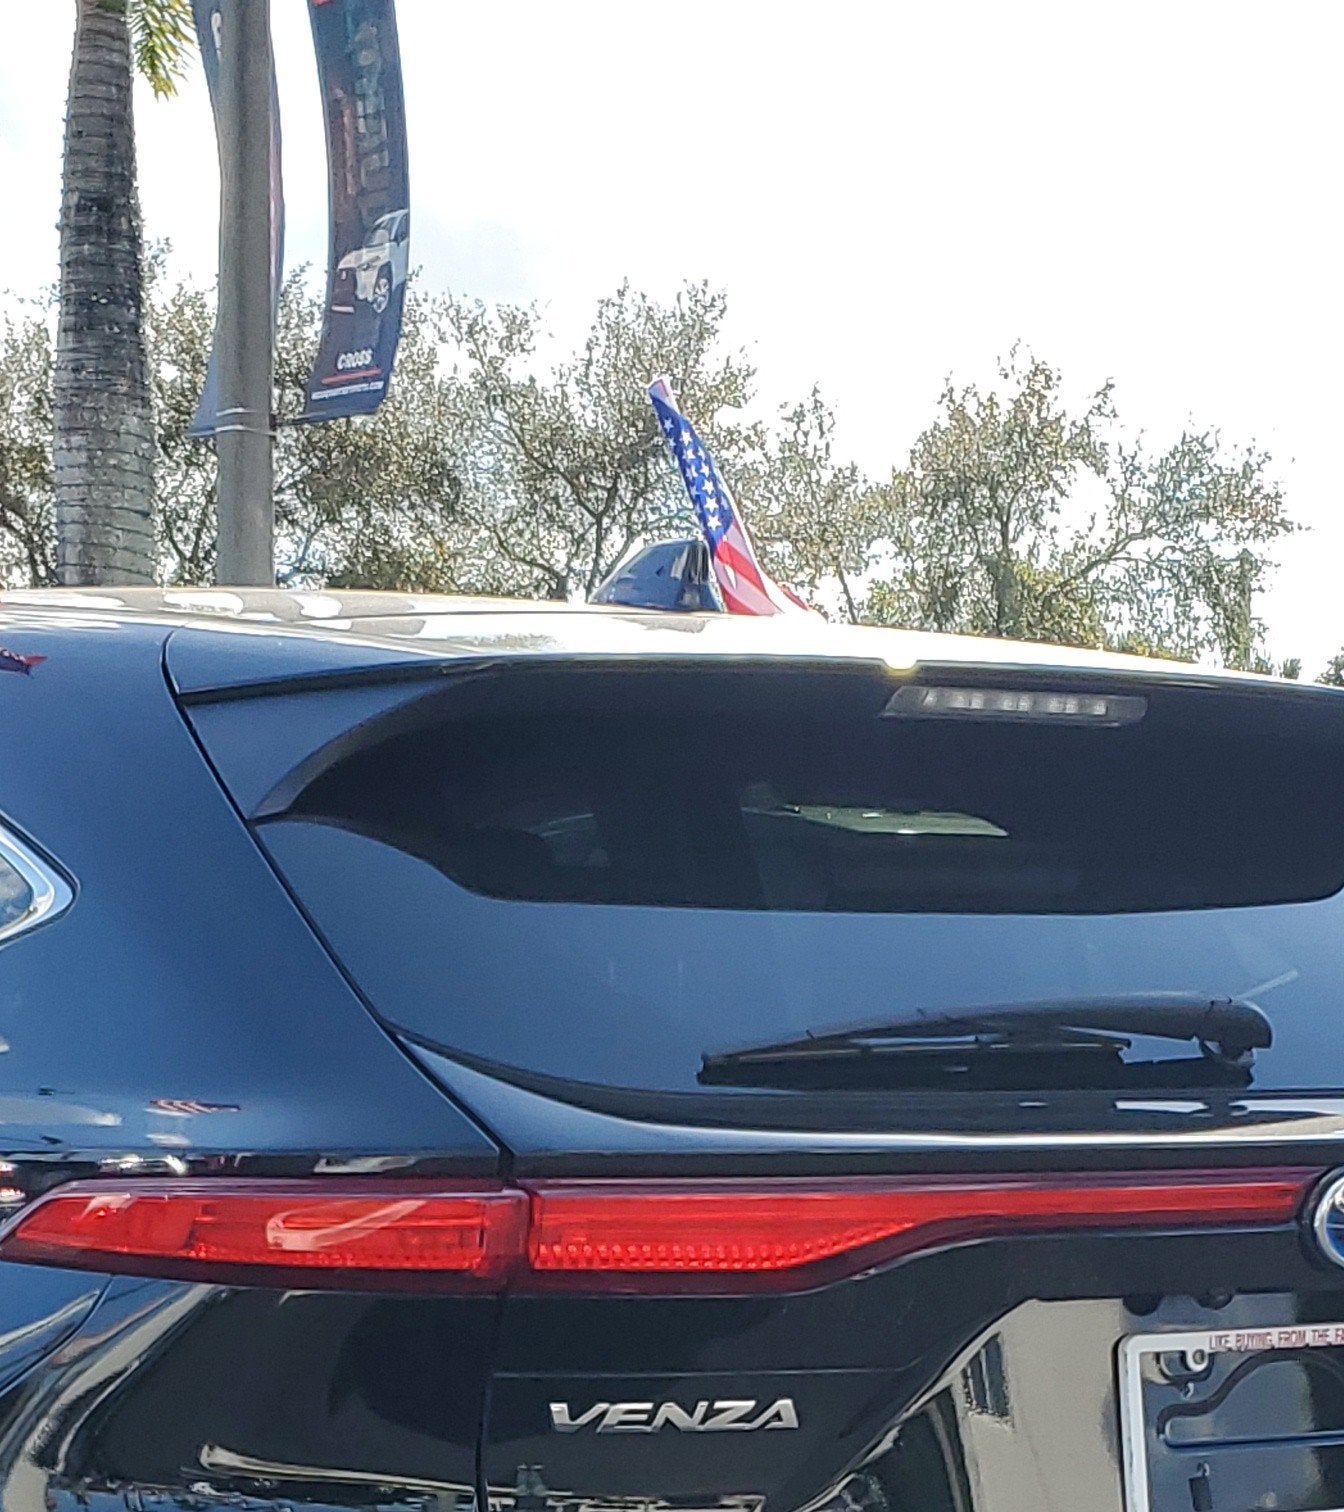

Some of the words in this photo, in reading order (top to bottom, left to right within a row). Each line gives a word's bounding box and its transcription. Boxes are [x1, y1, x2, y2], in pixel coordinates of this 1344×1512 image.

[1209, 1334, 1231, 1350] LIKE
[1278, 1330, 1306, 1348] FROM
[1311, 1328, 1330, 1345] THE
[549, 1398, 799, 1433] VENZA
